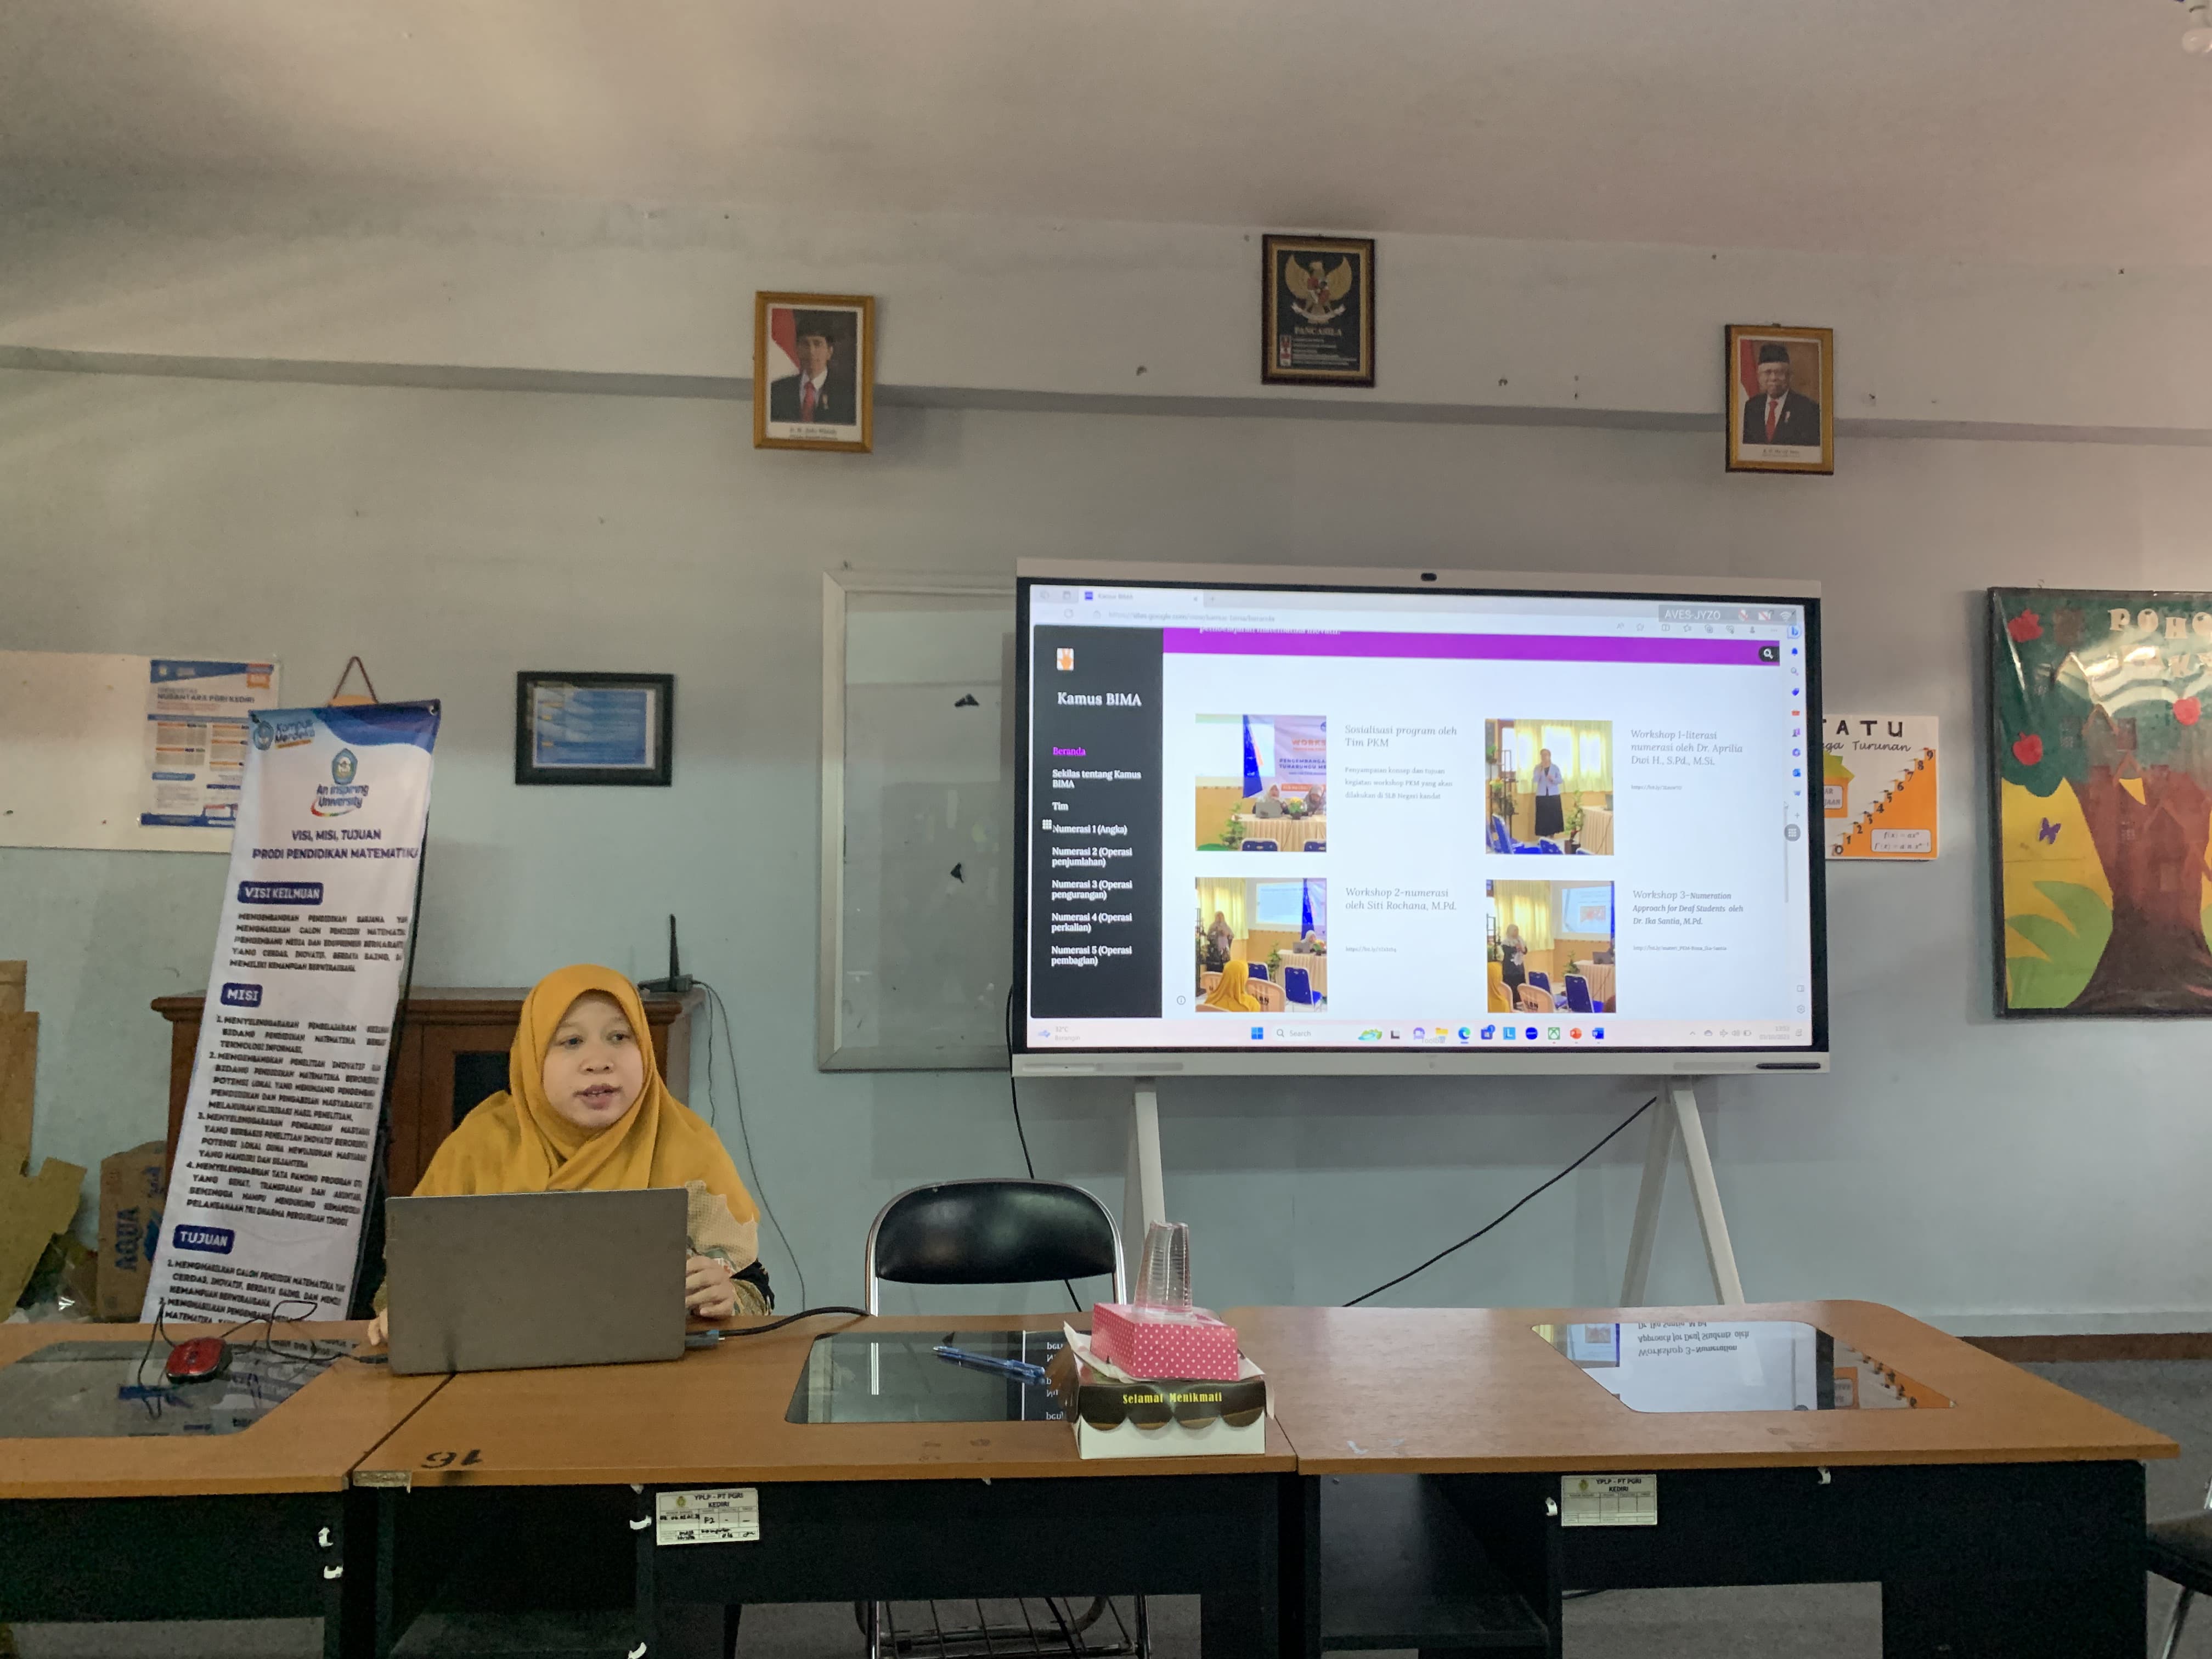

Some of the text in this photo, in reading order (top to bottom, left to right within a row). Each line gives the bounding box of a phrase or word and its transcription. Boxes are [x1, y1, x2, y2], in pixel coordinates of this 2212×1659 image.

[1664, 610, 1720, 620] AVES-JYZO
[1058, 692, 1142, 707] Kamus BIMA
[1345, 725, 1457, 737] Sosialisasi program oleh
[1822, 719, 1903, 737] ATU
[1630, 730, 1717, 741] Workshop 1-literasi
[1345, 738, 1389, 747] Tim PKM
[1822, 741, 1911, 753] ga Turunan
[1053, 747, 1086, 757] Beranda
[1675, 743, 1694, 752] oleh
[1697, 743, 1710, 752] Dr.
[1712, 744, 1743, 754] Aprilia
[1631, 755, 1650, 764] Dwi
[1926, 750, 1934, 760] 9
[1917, 760, 1924, 770] 8
[1052, 769, 1142, 781] Sekilas tentang Kamus
[1907, 770, 1914, 781] 7
[1052, 780, 1075, 789] BIMA
[1345, 778, 1372, 787] kegiatan
[1373, 779, 1404, 787] workshop
[1897, 782, 1904, 791] 6
[317, 783, 328, 795] An
[318, 795, 363, 809] University
[1052, 802, 1069, 811] Tim
[1876, 803, 1884, 814] 4
[341, 829, 381, 840] TUJUAN
[1053, 825, 1091, 833] Numerasi
[1097, 825, 1128, 836] (Angka)
[1857, 825, 1863, 834] 2
[1846, 836, 1851, 845] 1
[252, 848, 284, 860] PRODI
[287, 848, 347, 860] PENDIDIKAN
[1052, 847, 1132, 858] Numerasi 2 (Operasi
[1835, 845, 1843, 855] 0
[1052, 857, 1107, 868] penjumlahan)
[1052, 880, 1132, 891] Numerasi 3 (Operasi
[245, 888, 320, 899] VISI KEILMUAN
[1052, 891, 1107, 901] pengurangan)
[1346, 887, 1449, 899] Workshop 2-numerasi
[1633, 890, 1731, 901] Workshop 3-Numeration
[1345, 900, 1457, 911] oleh Siti Rochana, M.Pd.
[1667, 905, 1677, 913] for
[1679, 905, 1695, 913] Deaf
[1052, 913, 1132, 923] Numerasi 4 (Operasi
[1658, 918, 1682, 926] Santia,
[1051, 923, 1092, 934] perkalian)
[1051, 946, 1132, 957] Numerasi 5 (Operasi
[1051, 956, 1098, 967] pembagian)
[227, 989, 259, 1001] MISI
[180, 1231, 228, 1247] TUJUAN
[1122, 1392, 1222, 1404] Selamat Menikmati
